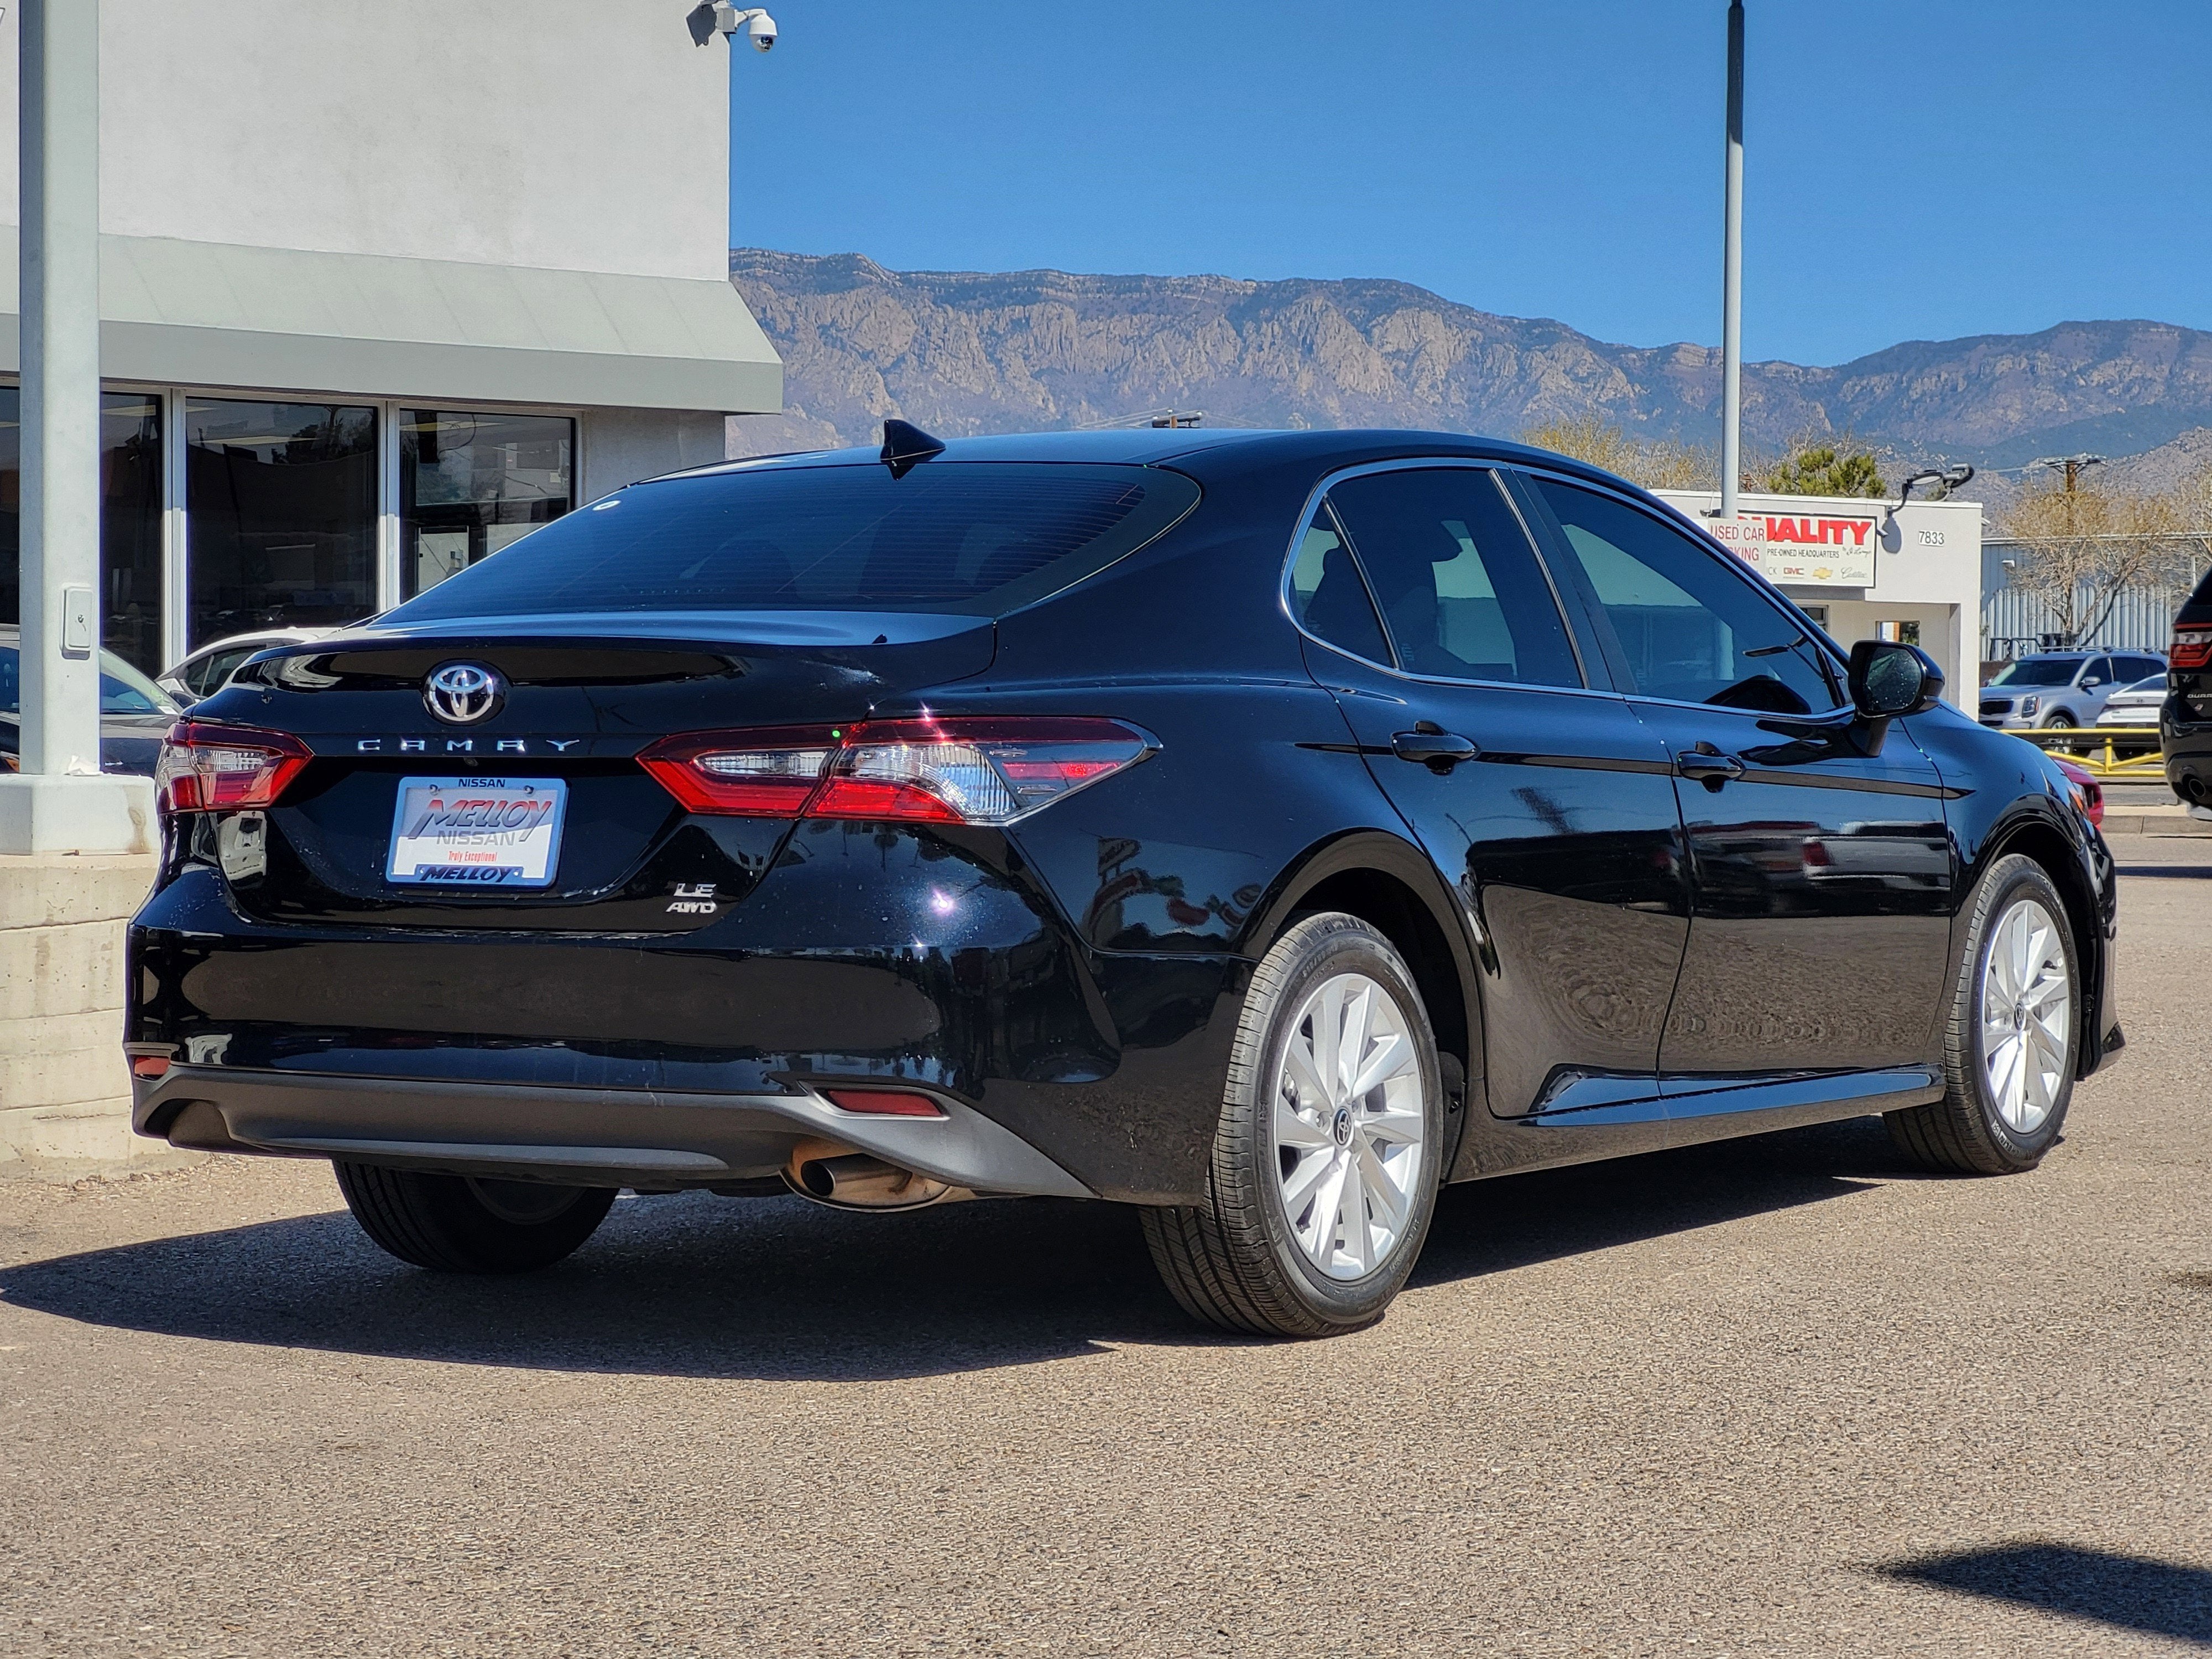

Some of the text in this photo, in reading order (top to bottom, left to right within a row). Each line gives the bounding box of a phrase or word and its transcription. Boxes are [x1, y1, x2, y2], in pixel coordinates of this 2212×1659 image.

[1711, 525, 1765, 541] USED CAR
[1738, 515, 1872, 545] UALITY
[1919, 531, 1944, 545] 7833
[1728, 546, 1759, 561] KING
[1767, 548, 1797, 557] PRE-OWNED
[1798, 549, 1840, 559] HEADQUARTERS
[358, 739, 580, 752] CAMRY
[458, 778, 505, 787] NISSAN
[408, 799, 552, 842] MELLOY
[436, 830, 515, 846] NISSAN
[448, 851, 498, 863] Truly Exceptional
[419, 866, 513, 883] MELLOY
[673, 883, 716, 898] LE
[665, 901, 717, 914] AWD
